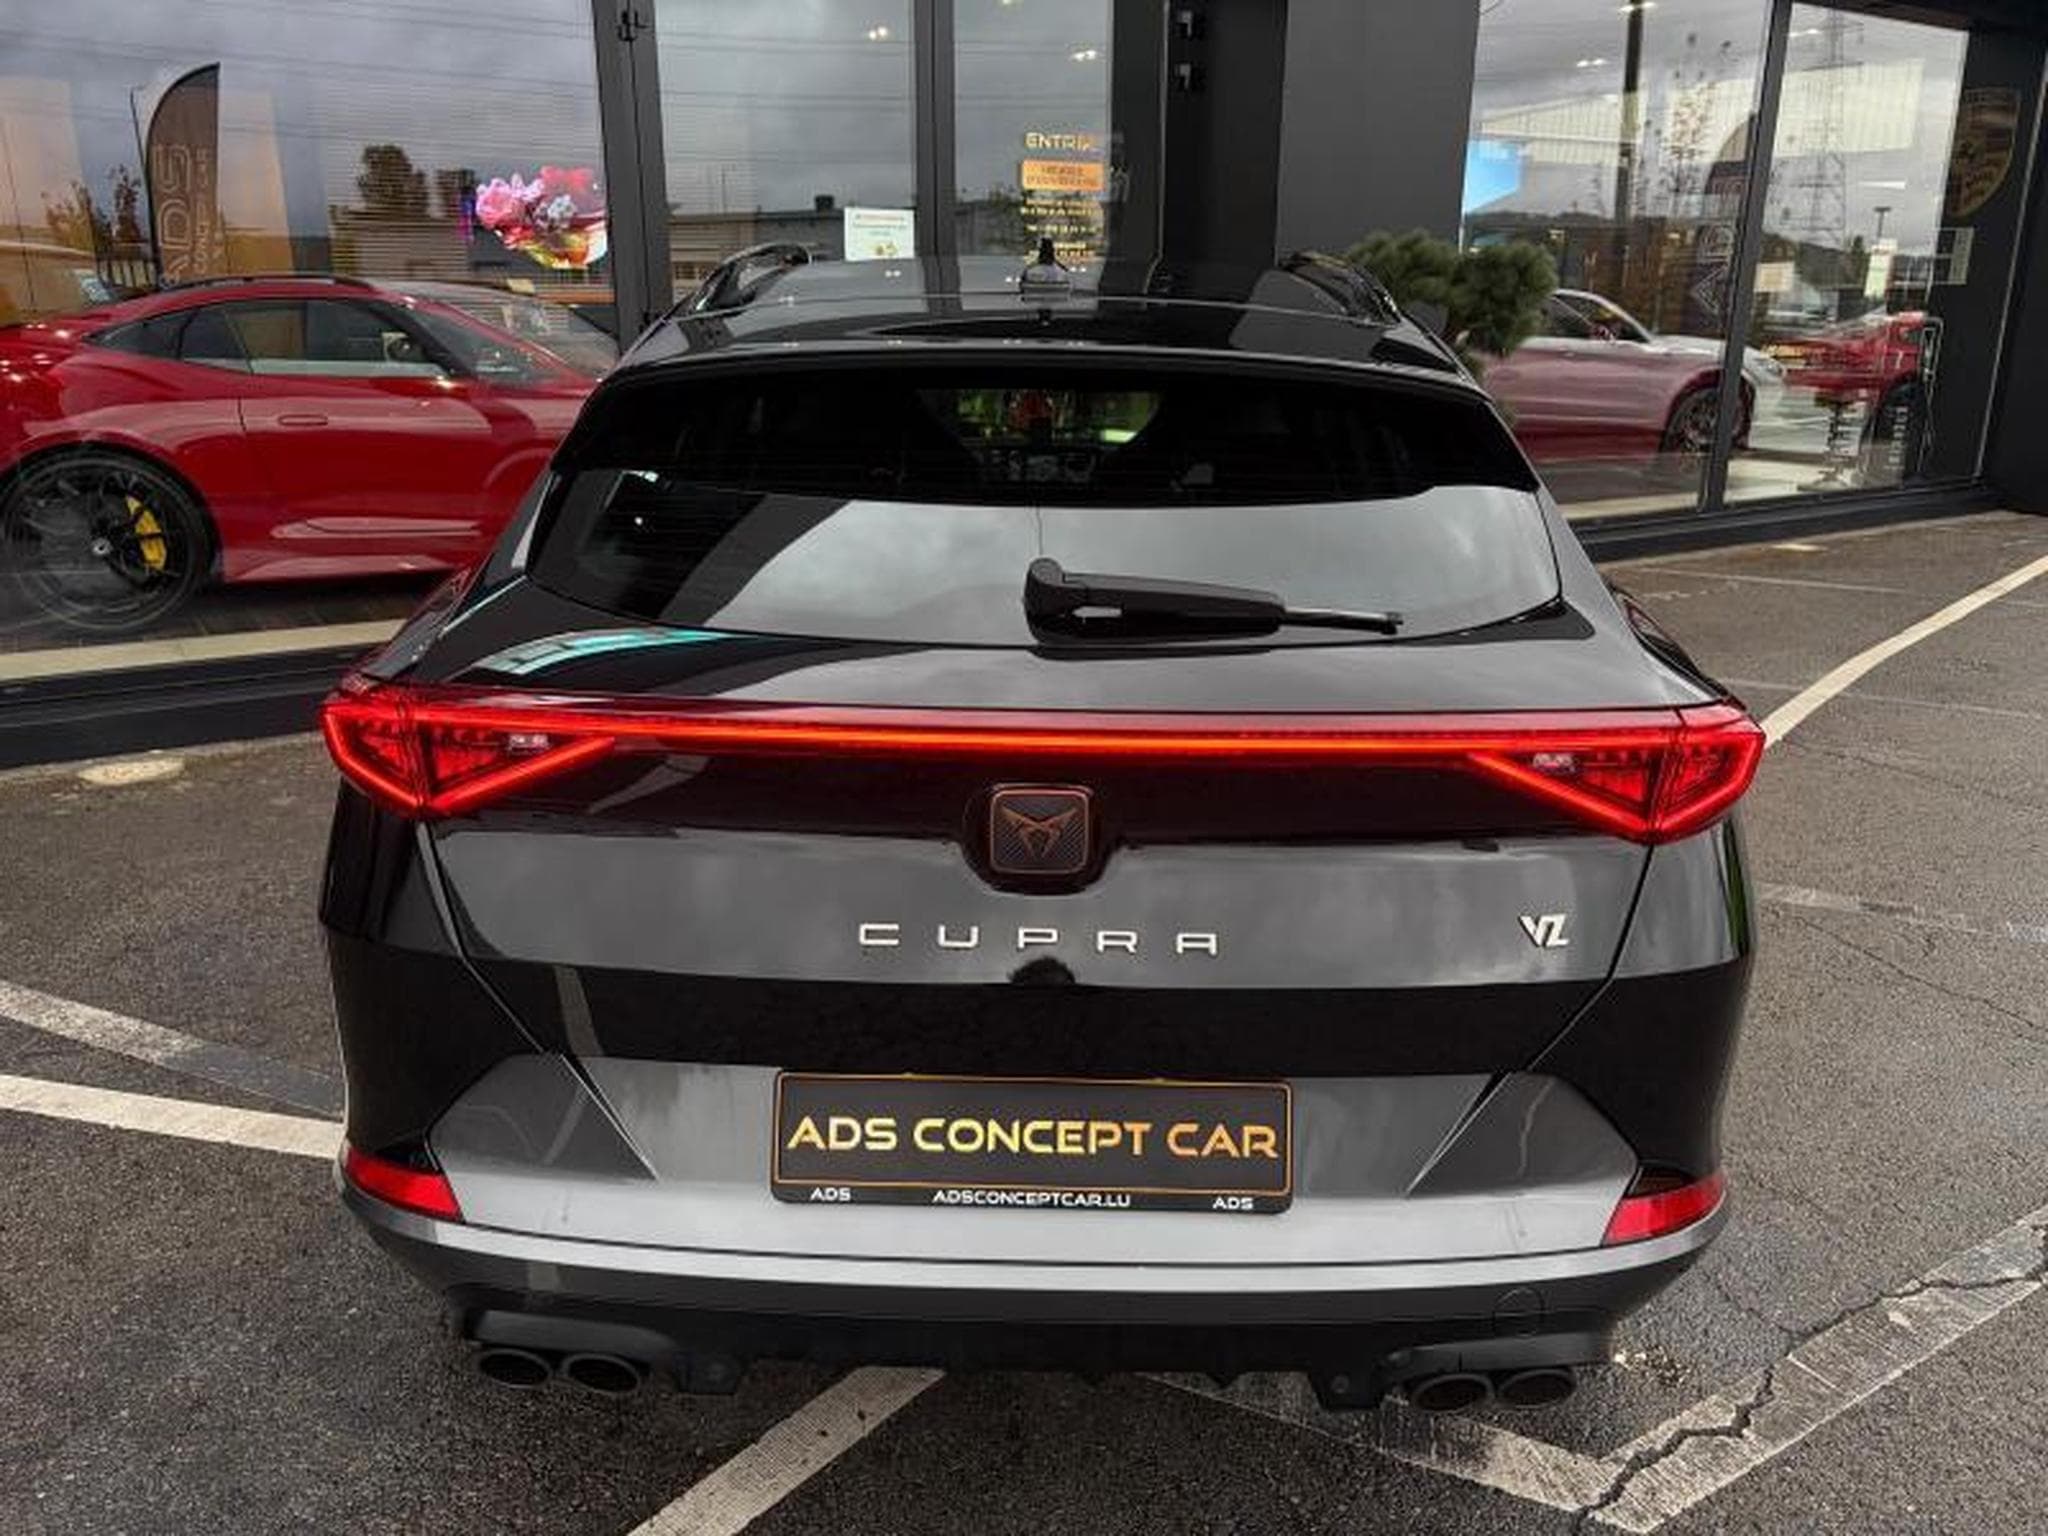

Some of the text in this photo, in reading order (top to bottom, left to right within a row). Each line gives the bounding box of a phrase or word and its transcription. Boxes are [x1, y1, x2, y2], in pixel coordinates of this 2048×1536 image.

[858, 922, 1218, 956] CUPRA
[1518, 913, 1570, 948] VZ
[786, 1114, 1280, 1159] ADS CONCEPT CAR
[809, 1186, 852, 1203] ADS
[931, 1188, 1131, 1208] ADSCONCEPTCAR.LU
[1211, 1196, 1254, 1211] ADS
